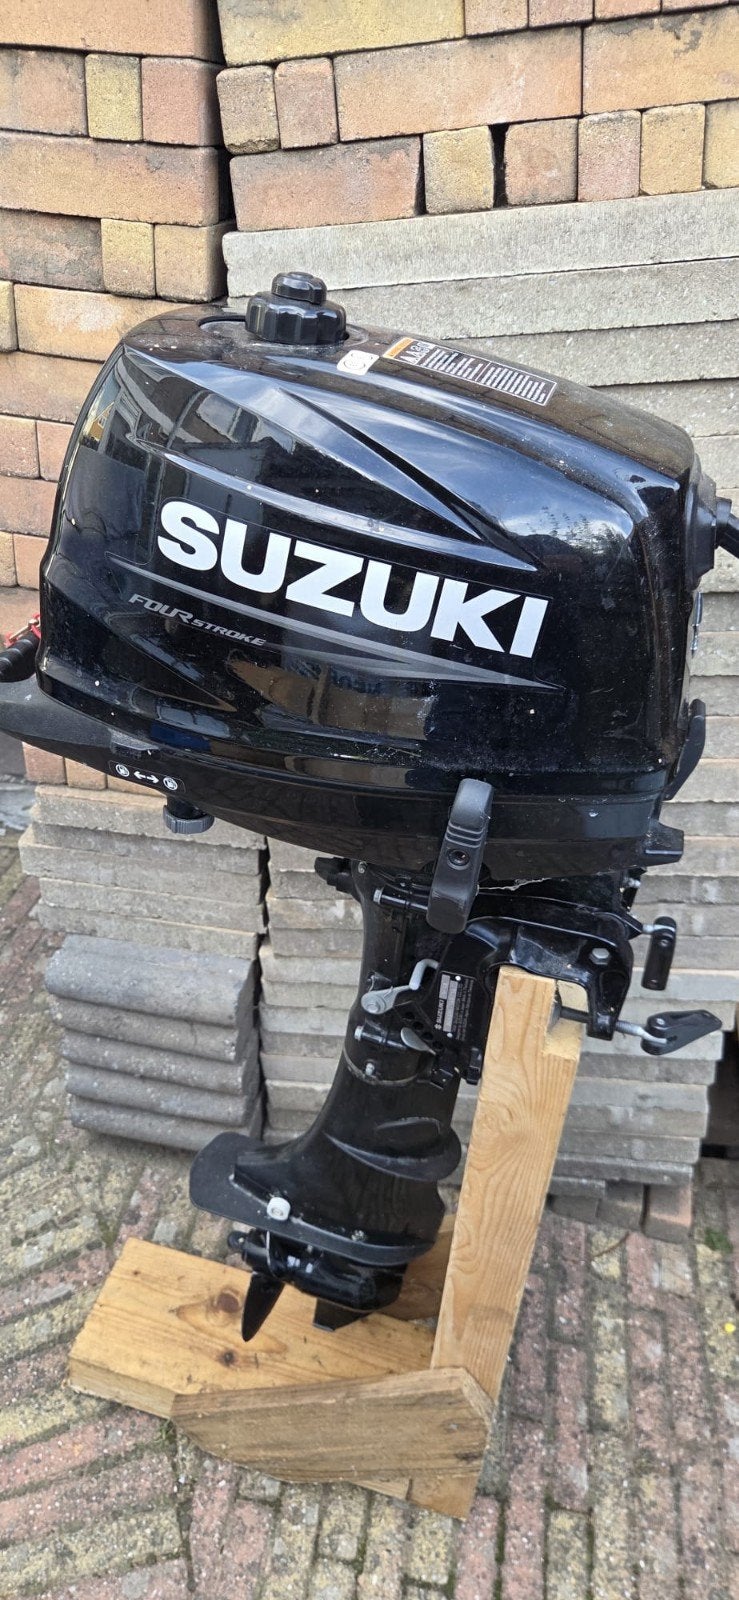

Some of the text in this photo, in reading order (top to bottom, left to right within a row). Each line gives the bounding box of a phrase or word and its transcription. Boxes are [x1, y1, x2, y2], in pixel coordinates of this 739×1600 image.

[157, 500, 549, 658] SUZUKI
[128, 593, 267, 646] FOUR STROKE
[436, 1000, 444, 1024] SUZUKI
